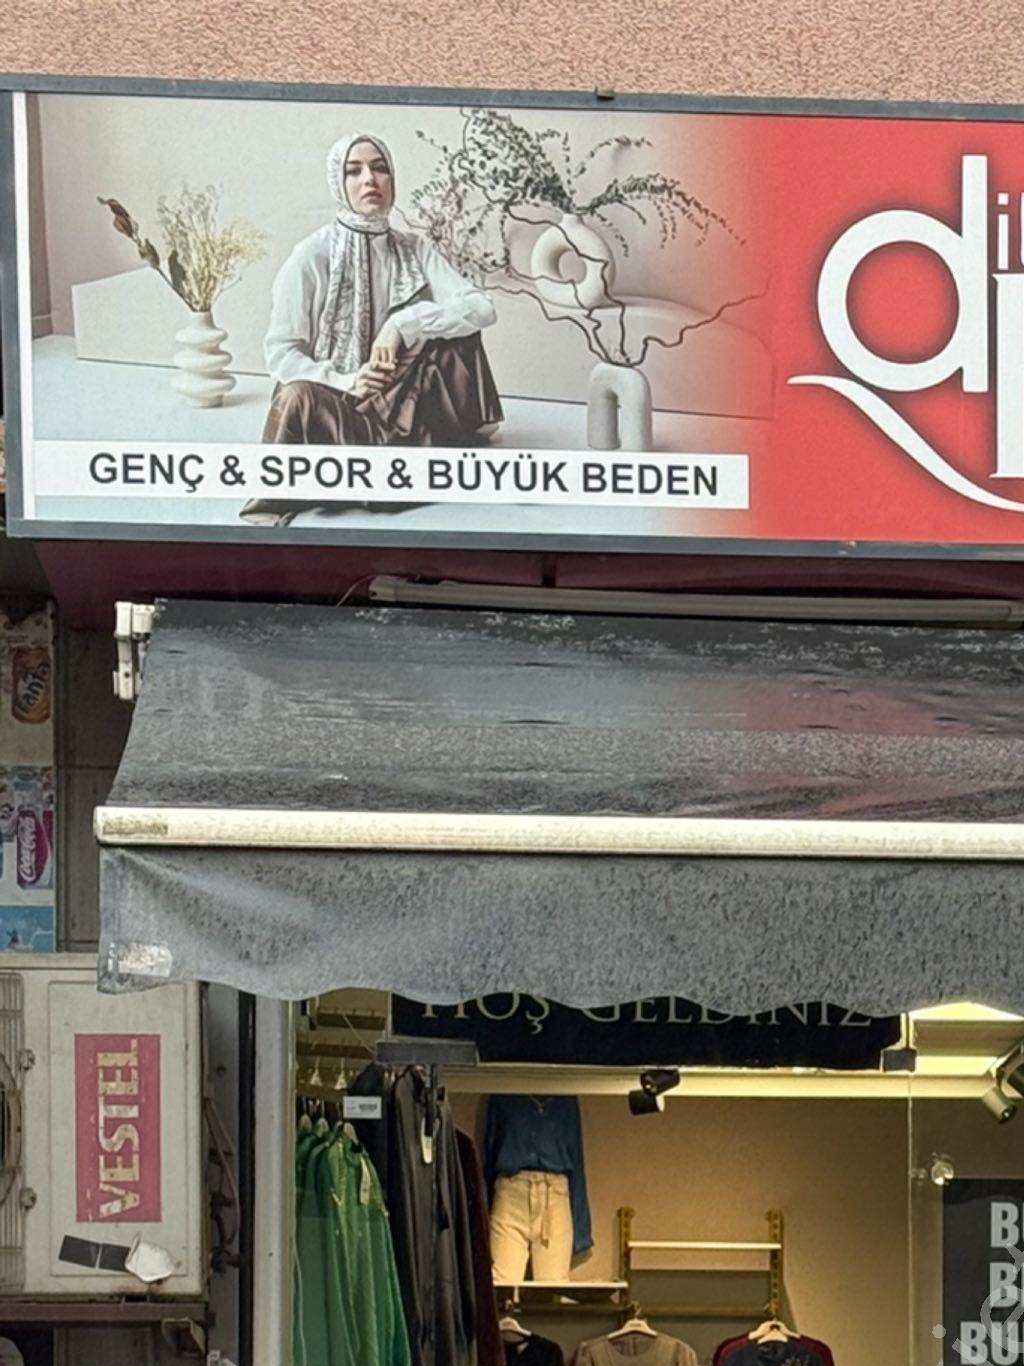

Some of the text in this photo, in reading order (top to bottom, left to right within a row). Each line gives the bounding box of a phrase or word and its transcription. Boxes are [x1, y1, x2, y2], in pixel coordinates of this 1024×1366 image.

[89, 452, 718, 497] GENÇ & SPOR & BÜYÜK BEDEN
[98, 1038, 140, 1218] VESTEL
